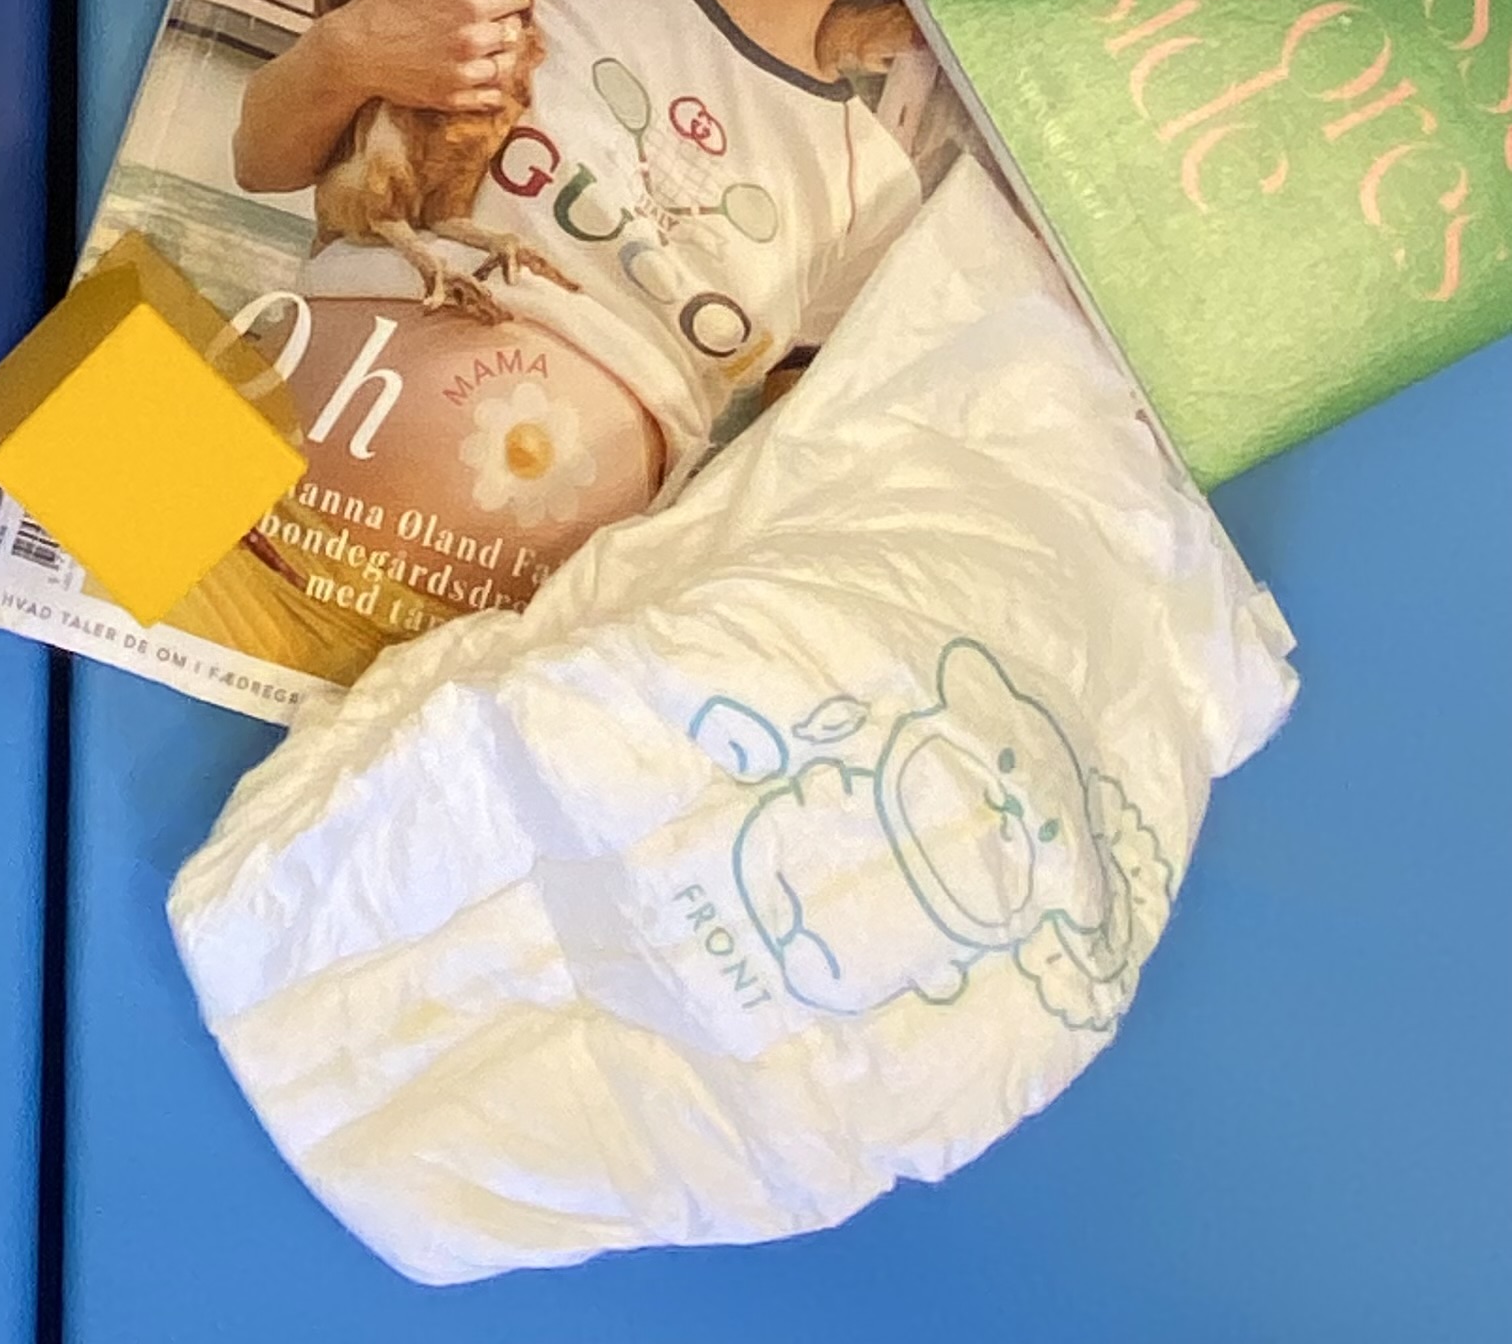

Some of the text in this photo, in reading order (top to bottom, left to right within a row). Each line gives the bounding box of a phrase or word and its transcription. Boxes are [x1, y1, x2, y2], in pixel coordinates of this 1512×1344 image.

[441, 349, 550, 407] MAMA
[303, 573, 381, 616] med
[0, 590, 52, 620] HVAD
[61, 610, 123, 649] TALER
[123, 632, 149, 654] DE
[156, 647, 188, 669] OM
[673, 883, 772, 1011] FRONT
